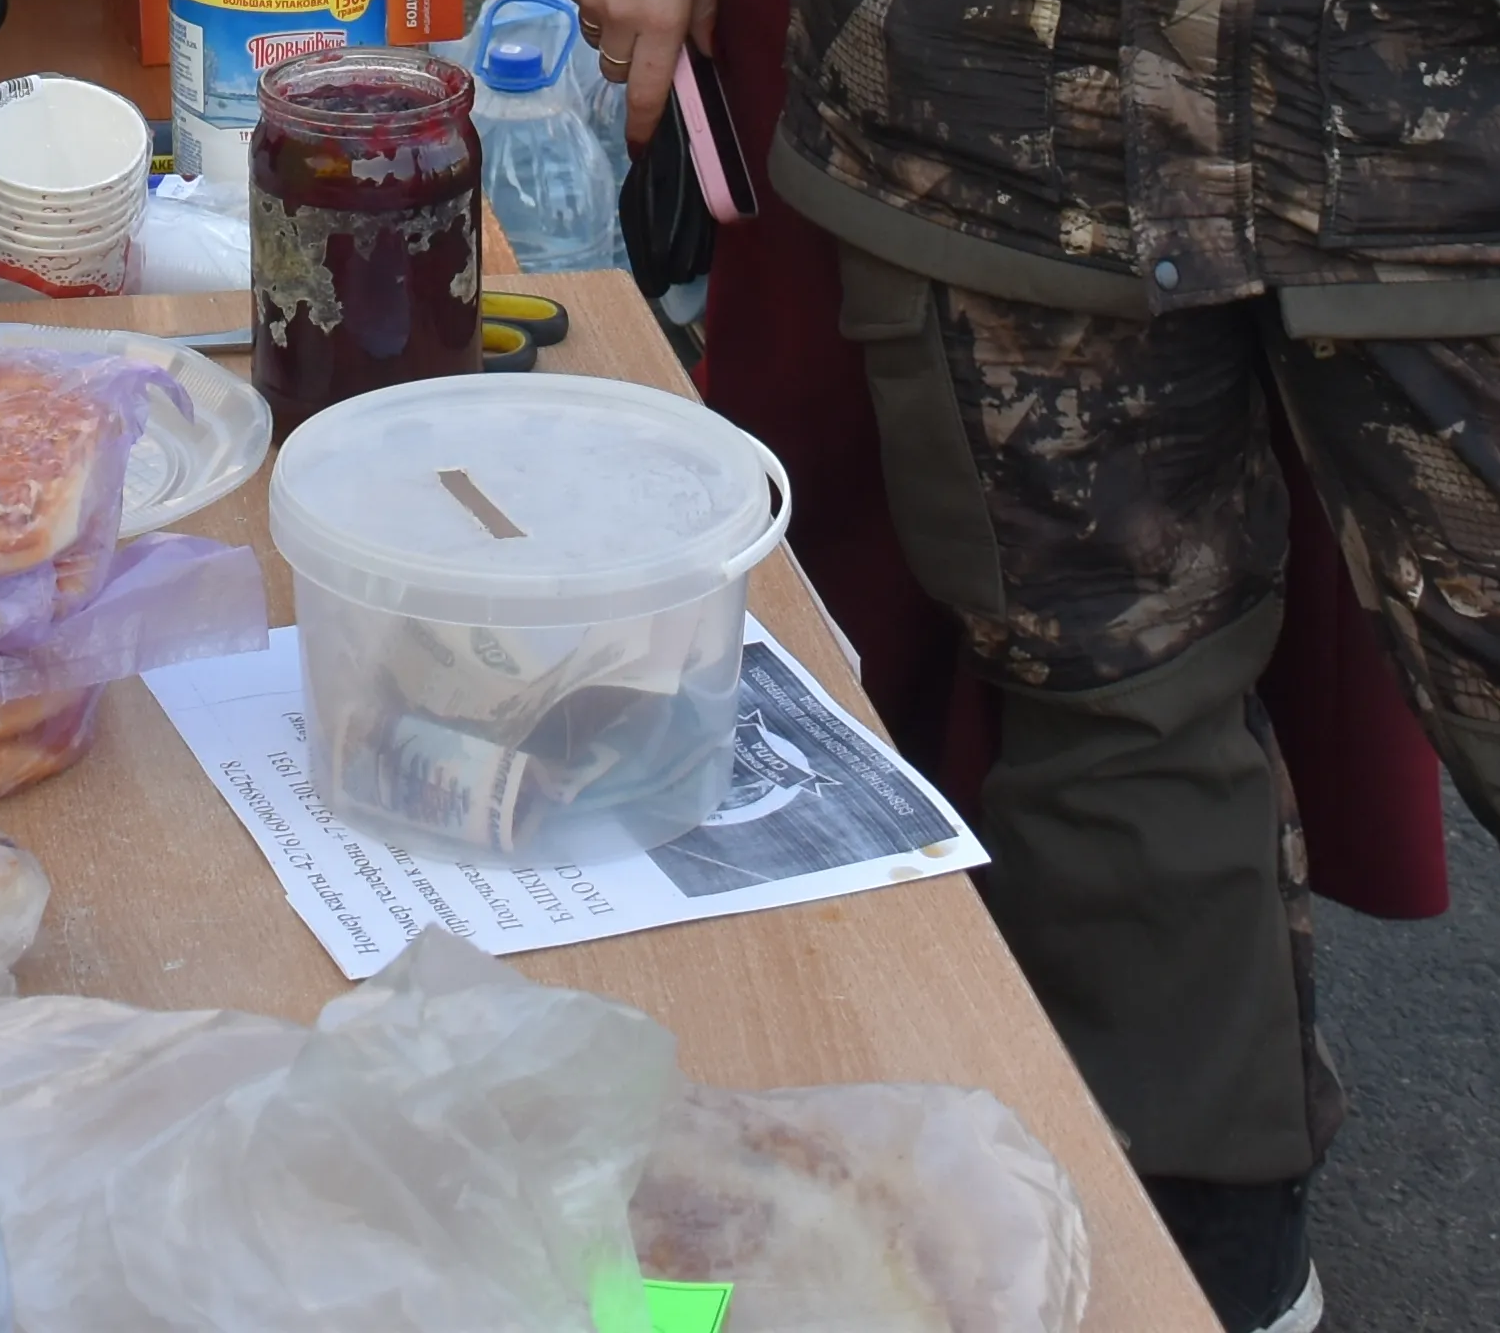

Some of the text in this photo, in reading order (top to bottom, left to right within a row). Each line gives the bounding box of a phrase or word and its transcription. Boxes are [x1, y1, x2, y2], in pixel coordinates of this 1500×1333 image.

[267, 750, 302, 778] 1931
[751, 741, 789, 771] СИЛА
[288, 779, 321, 801] 301
[305, 803, 337, 824] 937
[343, 842, 397, 905] телефона
[403, 867, 419, 878] к
[307, 873, 346, 912] карты
[455, 861, 523, 931] Получател
[571, 881, 615, 916] ПАО
[336, 915, 380, 955] Номер
